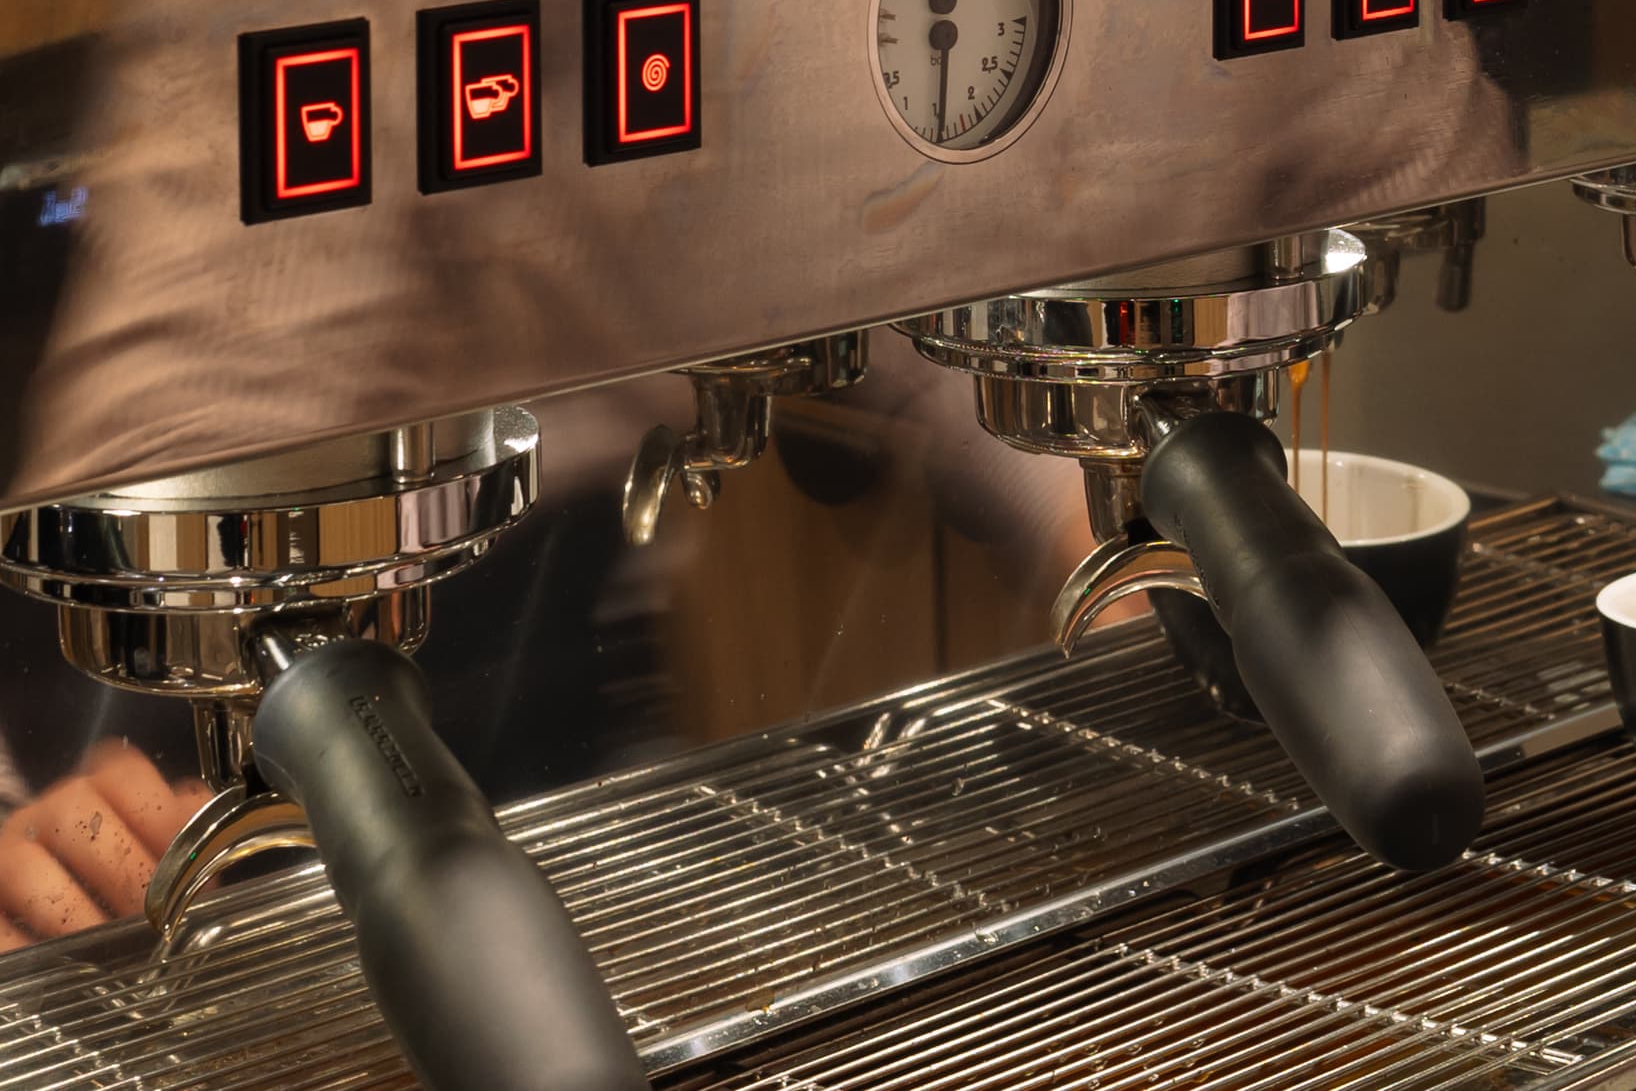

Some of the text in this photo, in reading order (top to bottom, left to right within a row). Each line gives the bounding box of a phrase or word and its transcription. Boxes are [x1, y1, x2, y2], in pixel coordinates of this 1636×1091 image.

[997, 22, 1005, 36] 3
[981, 56, 998, 74] 2,5
[967, 85, 975, 100] 2
[903, 96, 909, 111] 1
